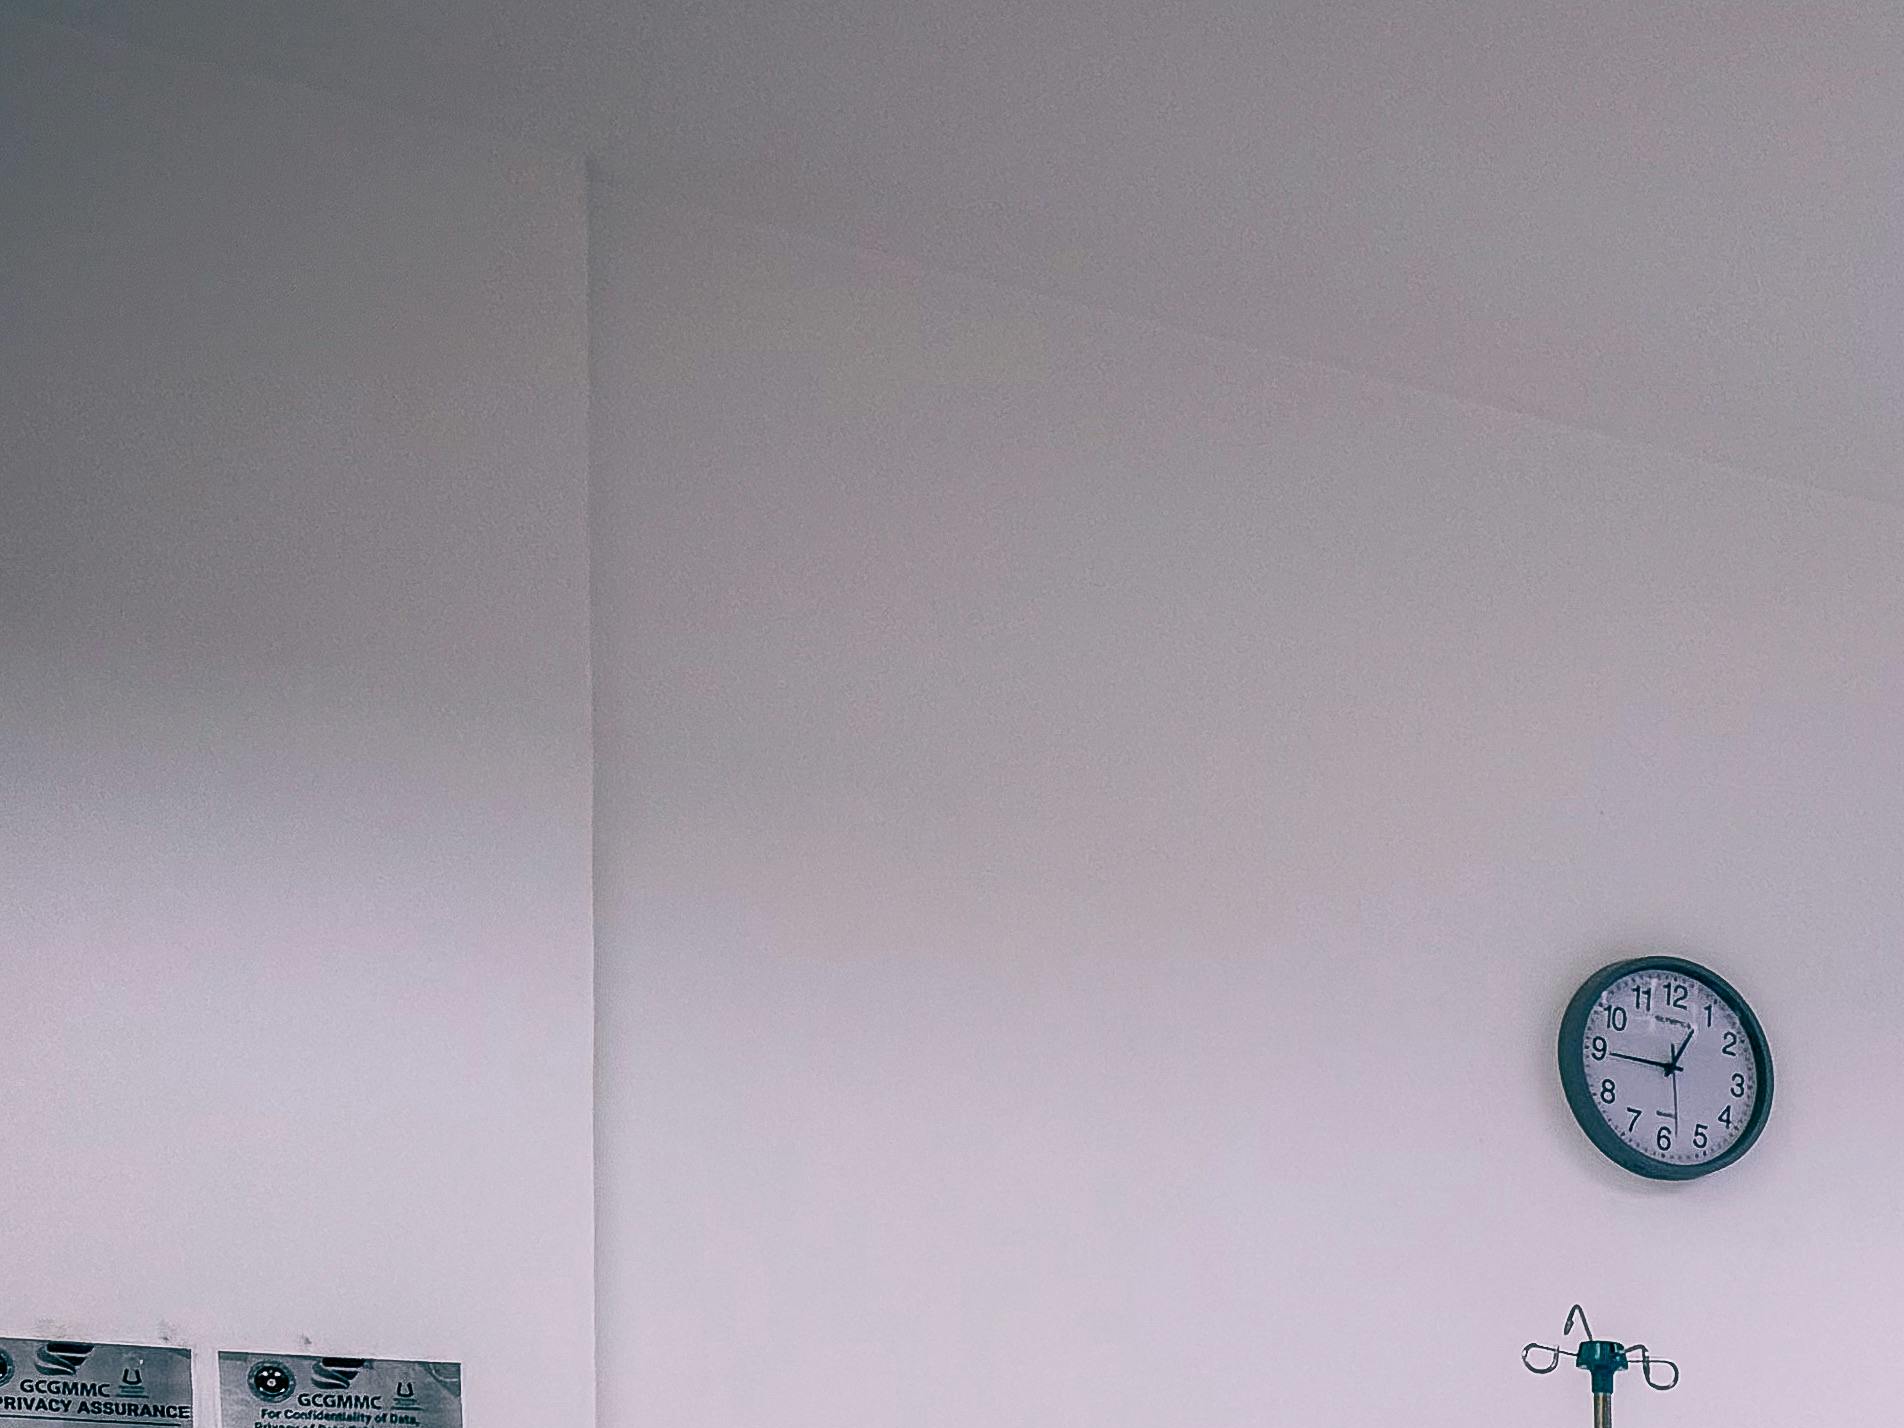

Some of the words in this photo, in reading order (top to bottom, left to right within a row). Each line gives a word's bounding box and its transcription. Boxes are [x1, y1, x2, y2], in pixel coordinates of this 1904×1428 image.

[1633, 985, 1651, 1011] 11
[1664, 982, 1688, 1010] 12
[1604, 1005, 1626, 1031] 10
[1704, 1004, 1712, 1027] 1
[1592, 1036, 1607, 1060] 9
[1722, 1032, 1737, 1056] 2
[1601, 1079, 1615, 1103] 8
[1731, 1073, 1744, 1097] 3
[1627, 1107, 1642, 1132] 7
[1719, 1106, 1731, 1129] 4
[1657, 1127, 1671, 1151] 6
[1693, 1124, 1708, 1148] 5
[20, 1380, 110, 1397] GCGMMC
[78, 1401, 191, 1418] ASSURANCE
[298, 1394, 382, 1410] GCGMMC
[261, 1409, 281, 1418] For
[284, 1410, 372, 1425] Confidentiality
[375, 1413, 387, 1423] of
